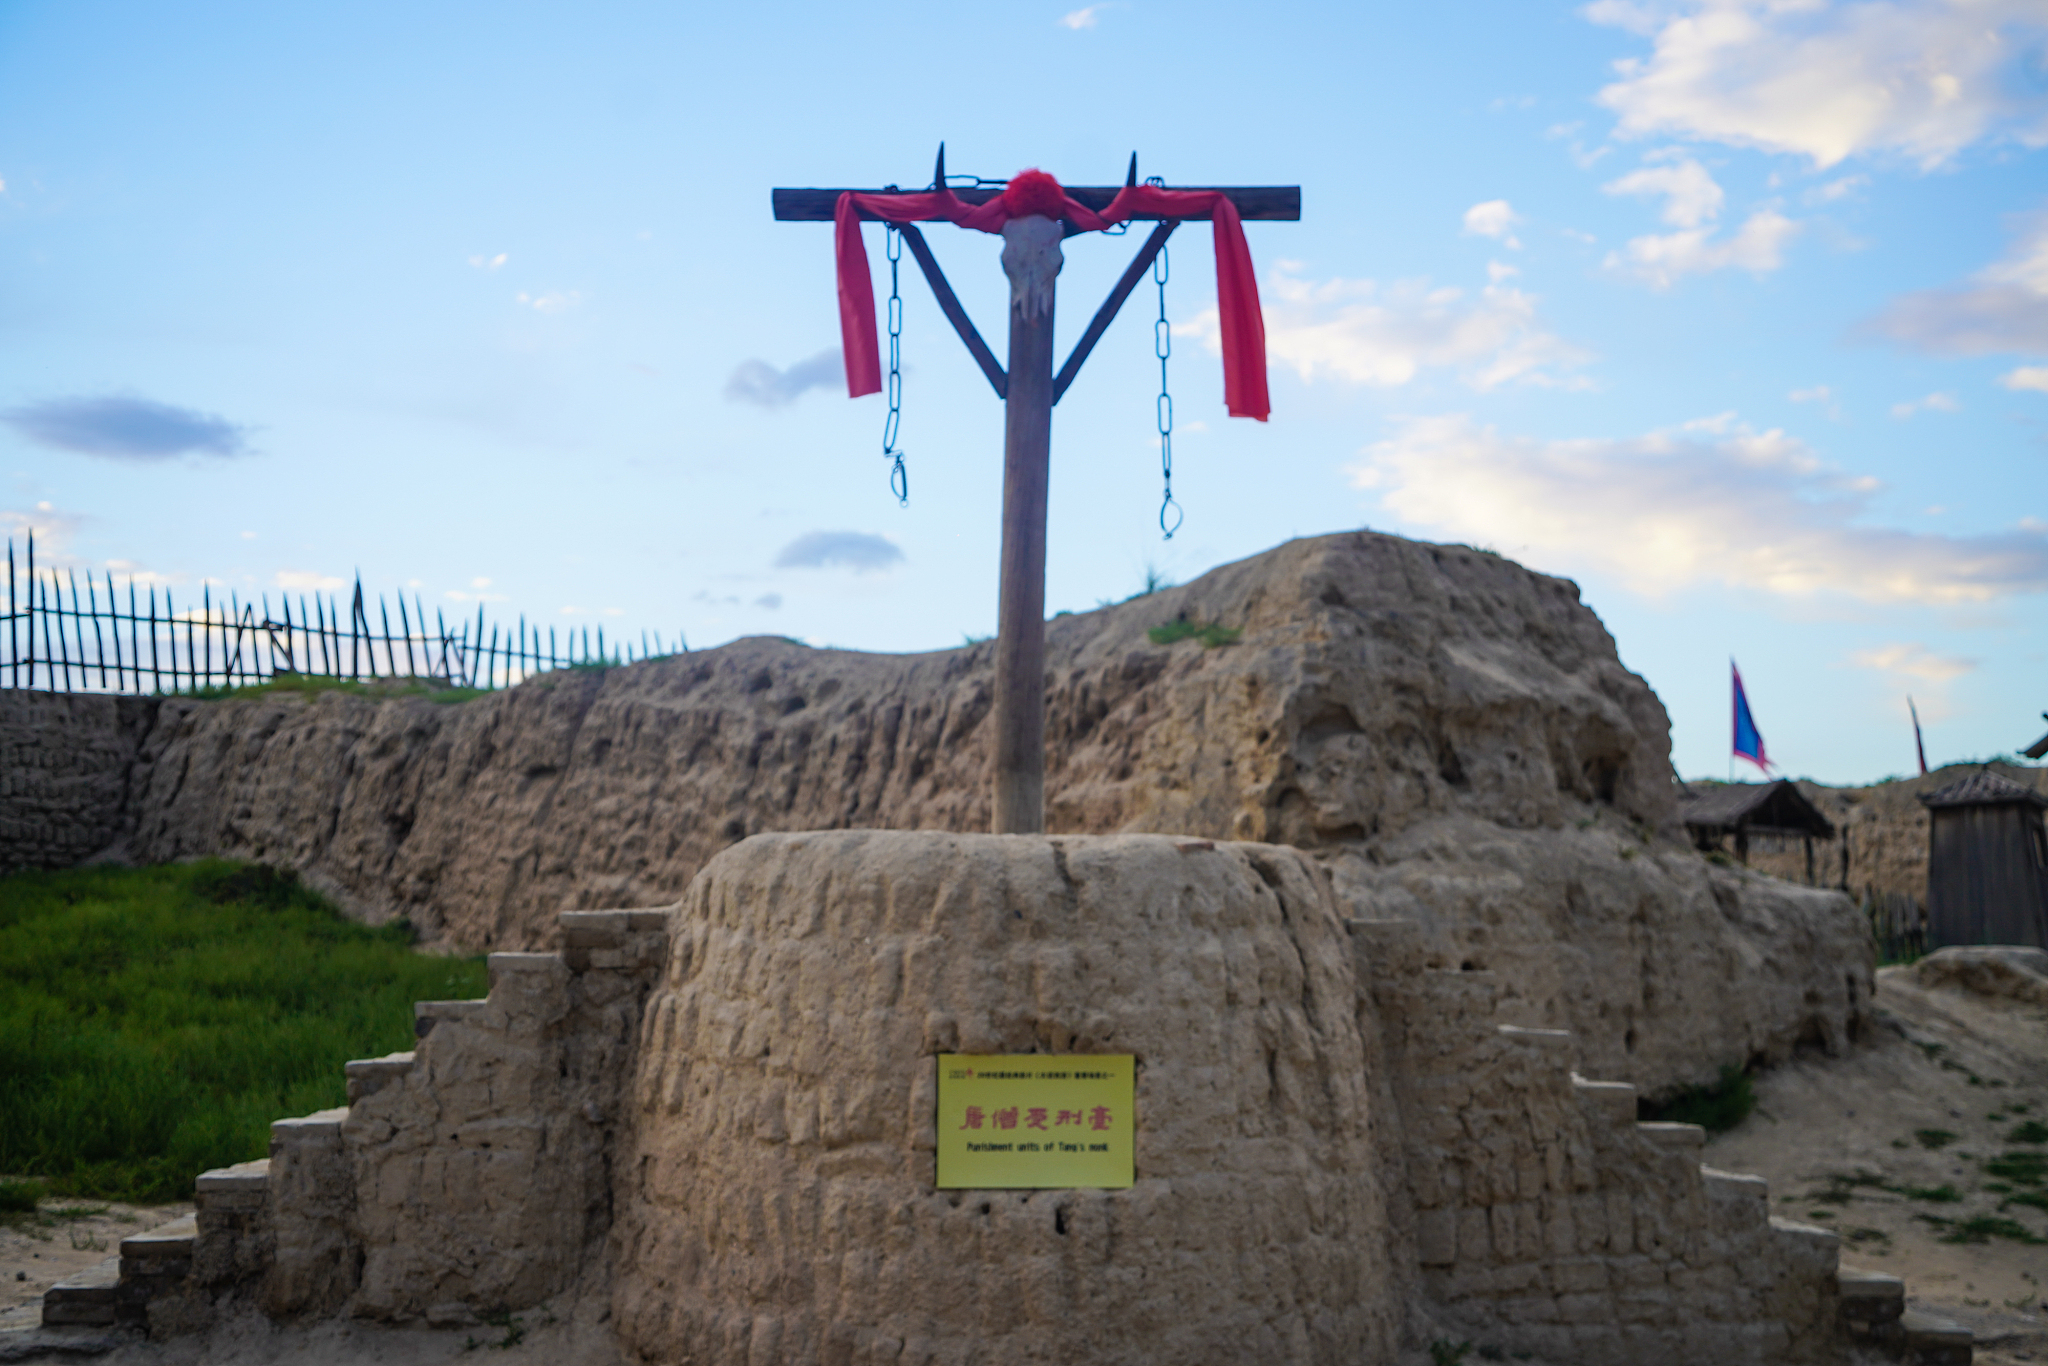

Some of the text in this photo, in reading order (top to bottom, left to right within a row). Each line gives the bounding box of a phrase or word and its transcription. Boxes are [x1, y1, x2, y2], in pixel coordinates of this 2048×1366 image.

[966, 1141, 1013, 1152] Punishment
[1016, 1141, 1040, 1152] units
[1043, 1141, 1055, 1152] of
